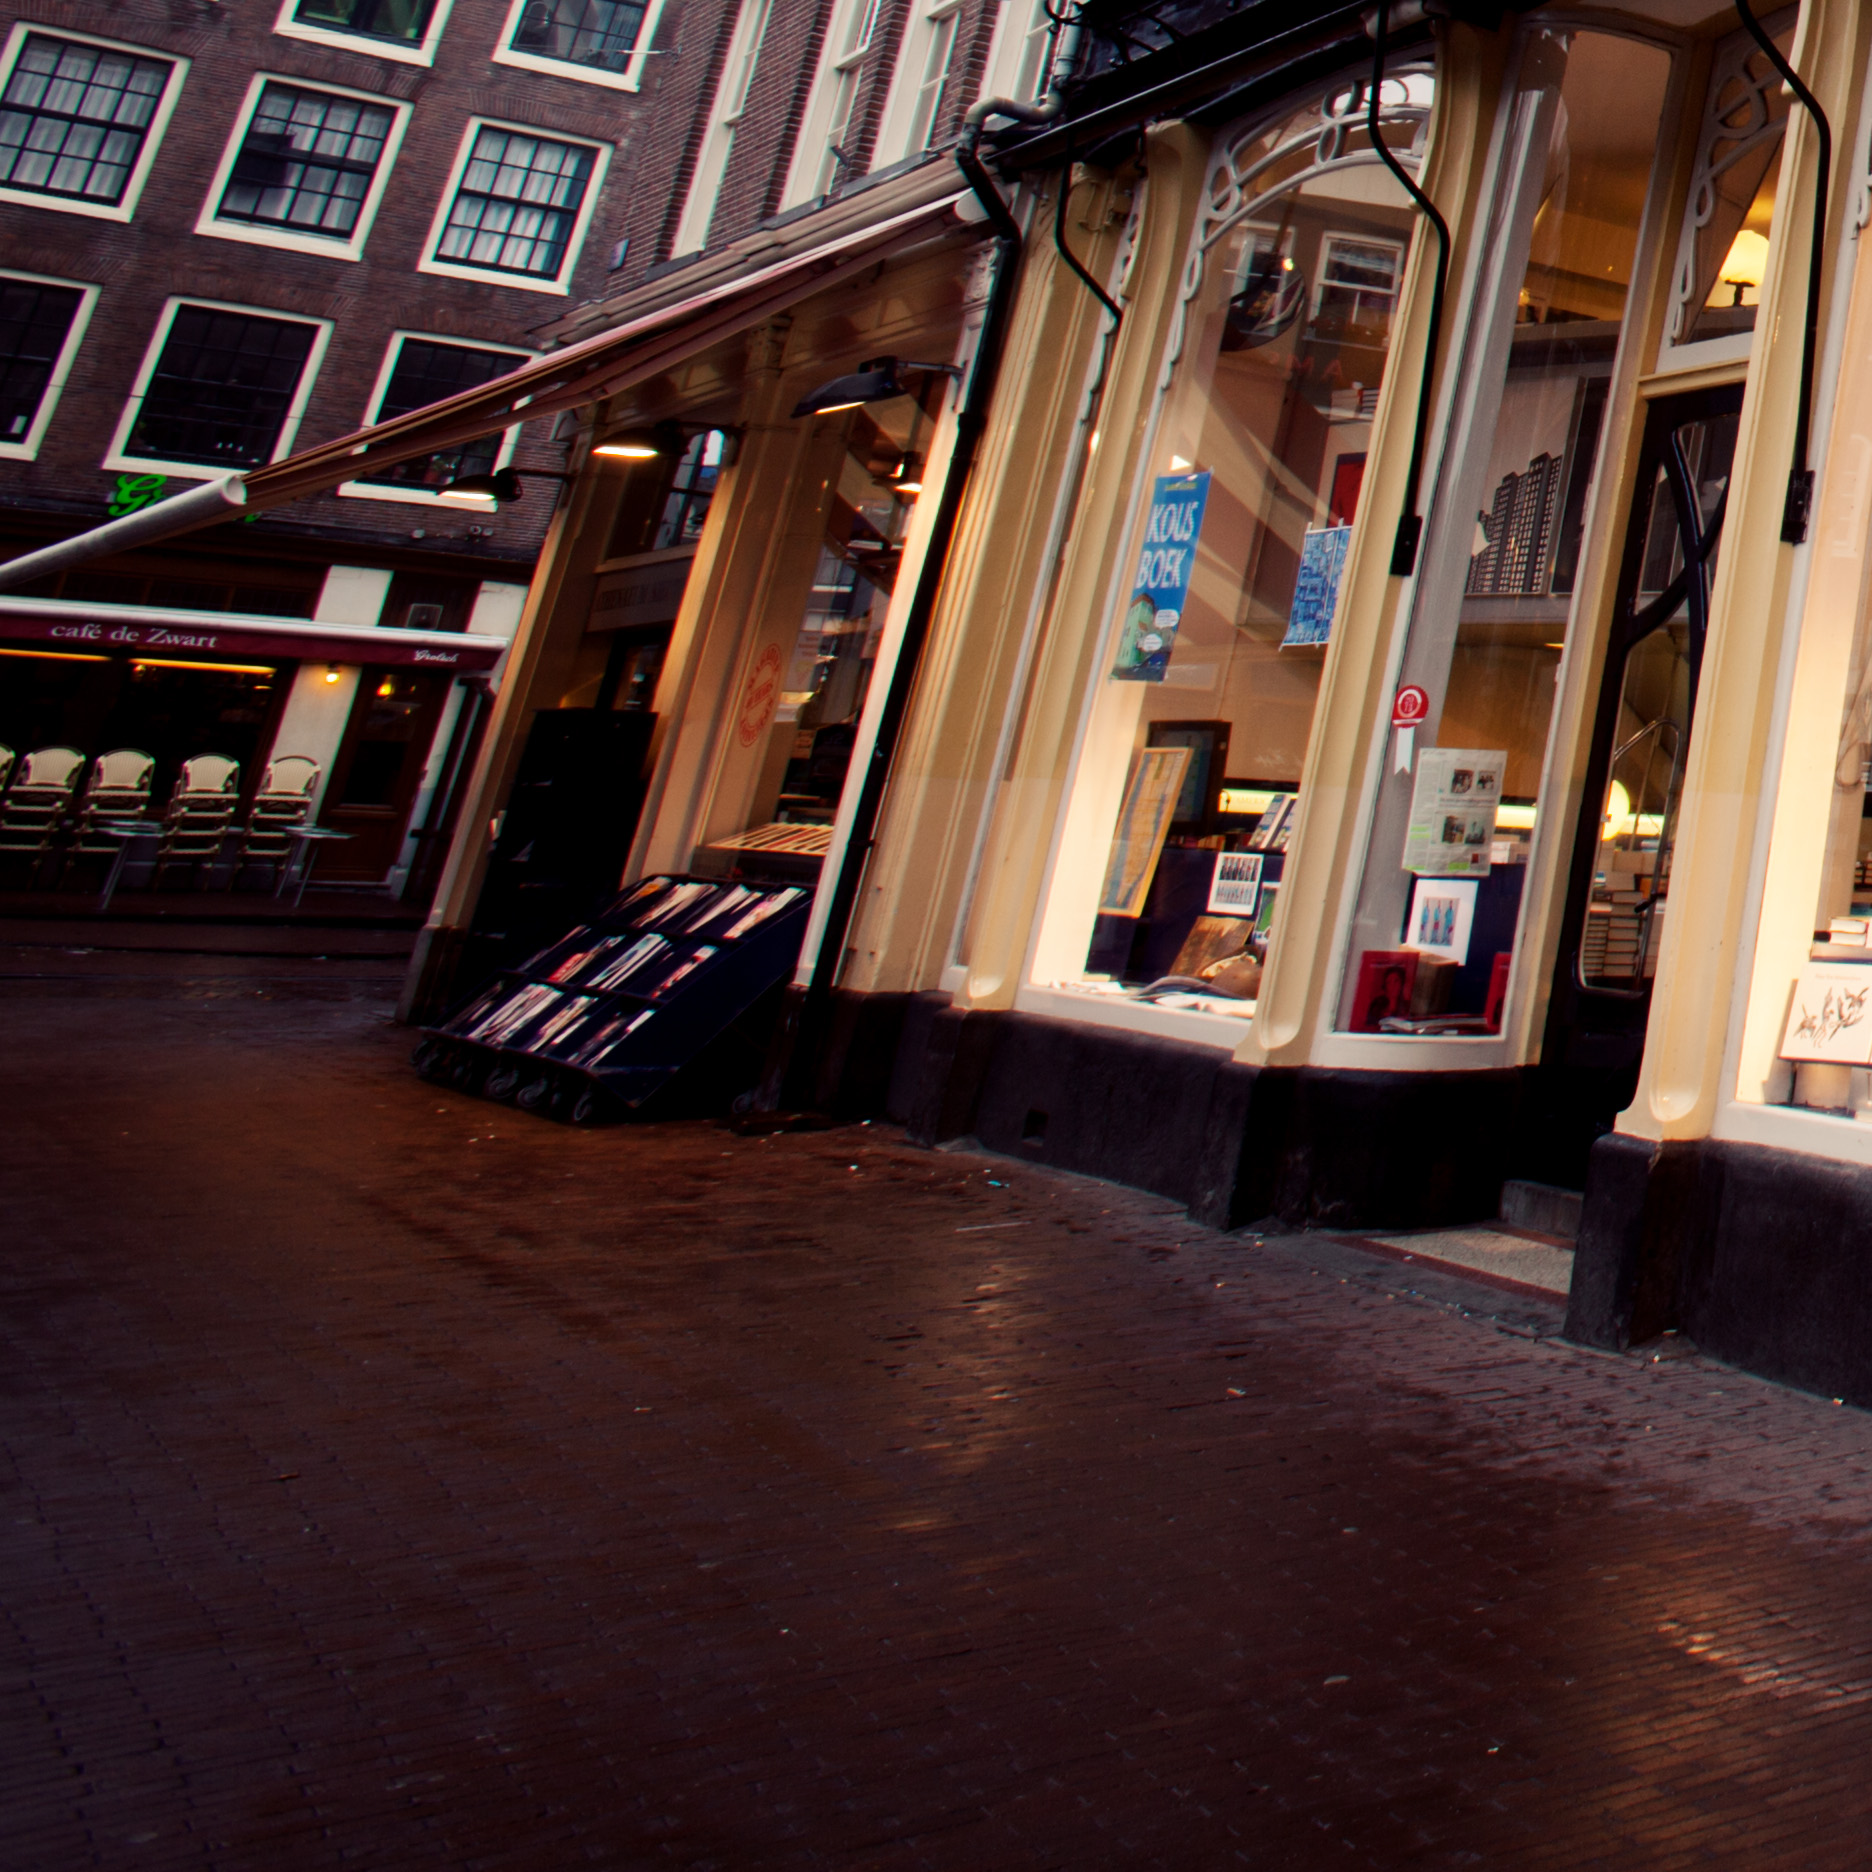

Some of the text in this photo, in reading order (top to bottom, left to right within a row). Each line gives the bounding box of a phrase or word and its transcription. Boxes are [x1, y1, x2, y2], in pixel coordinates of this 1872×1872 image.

[51, 623, 217, 648] café de Zwart
